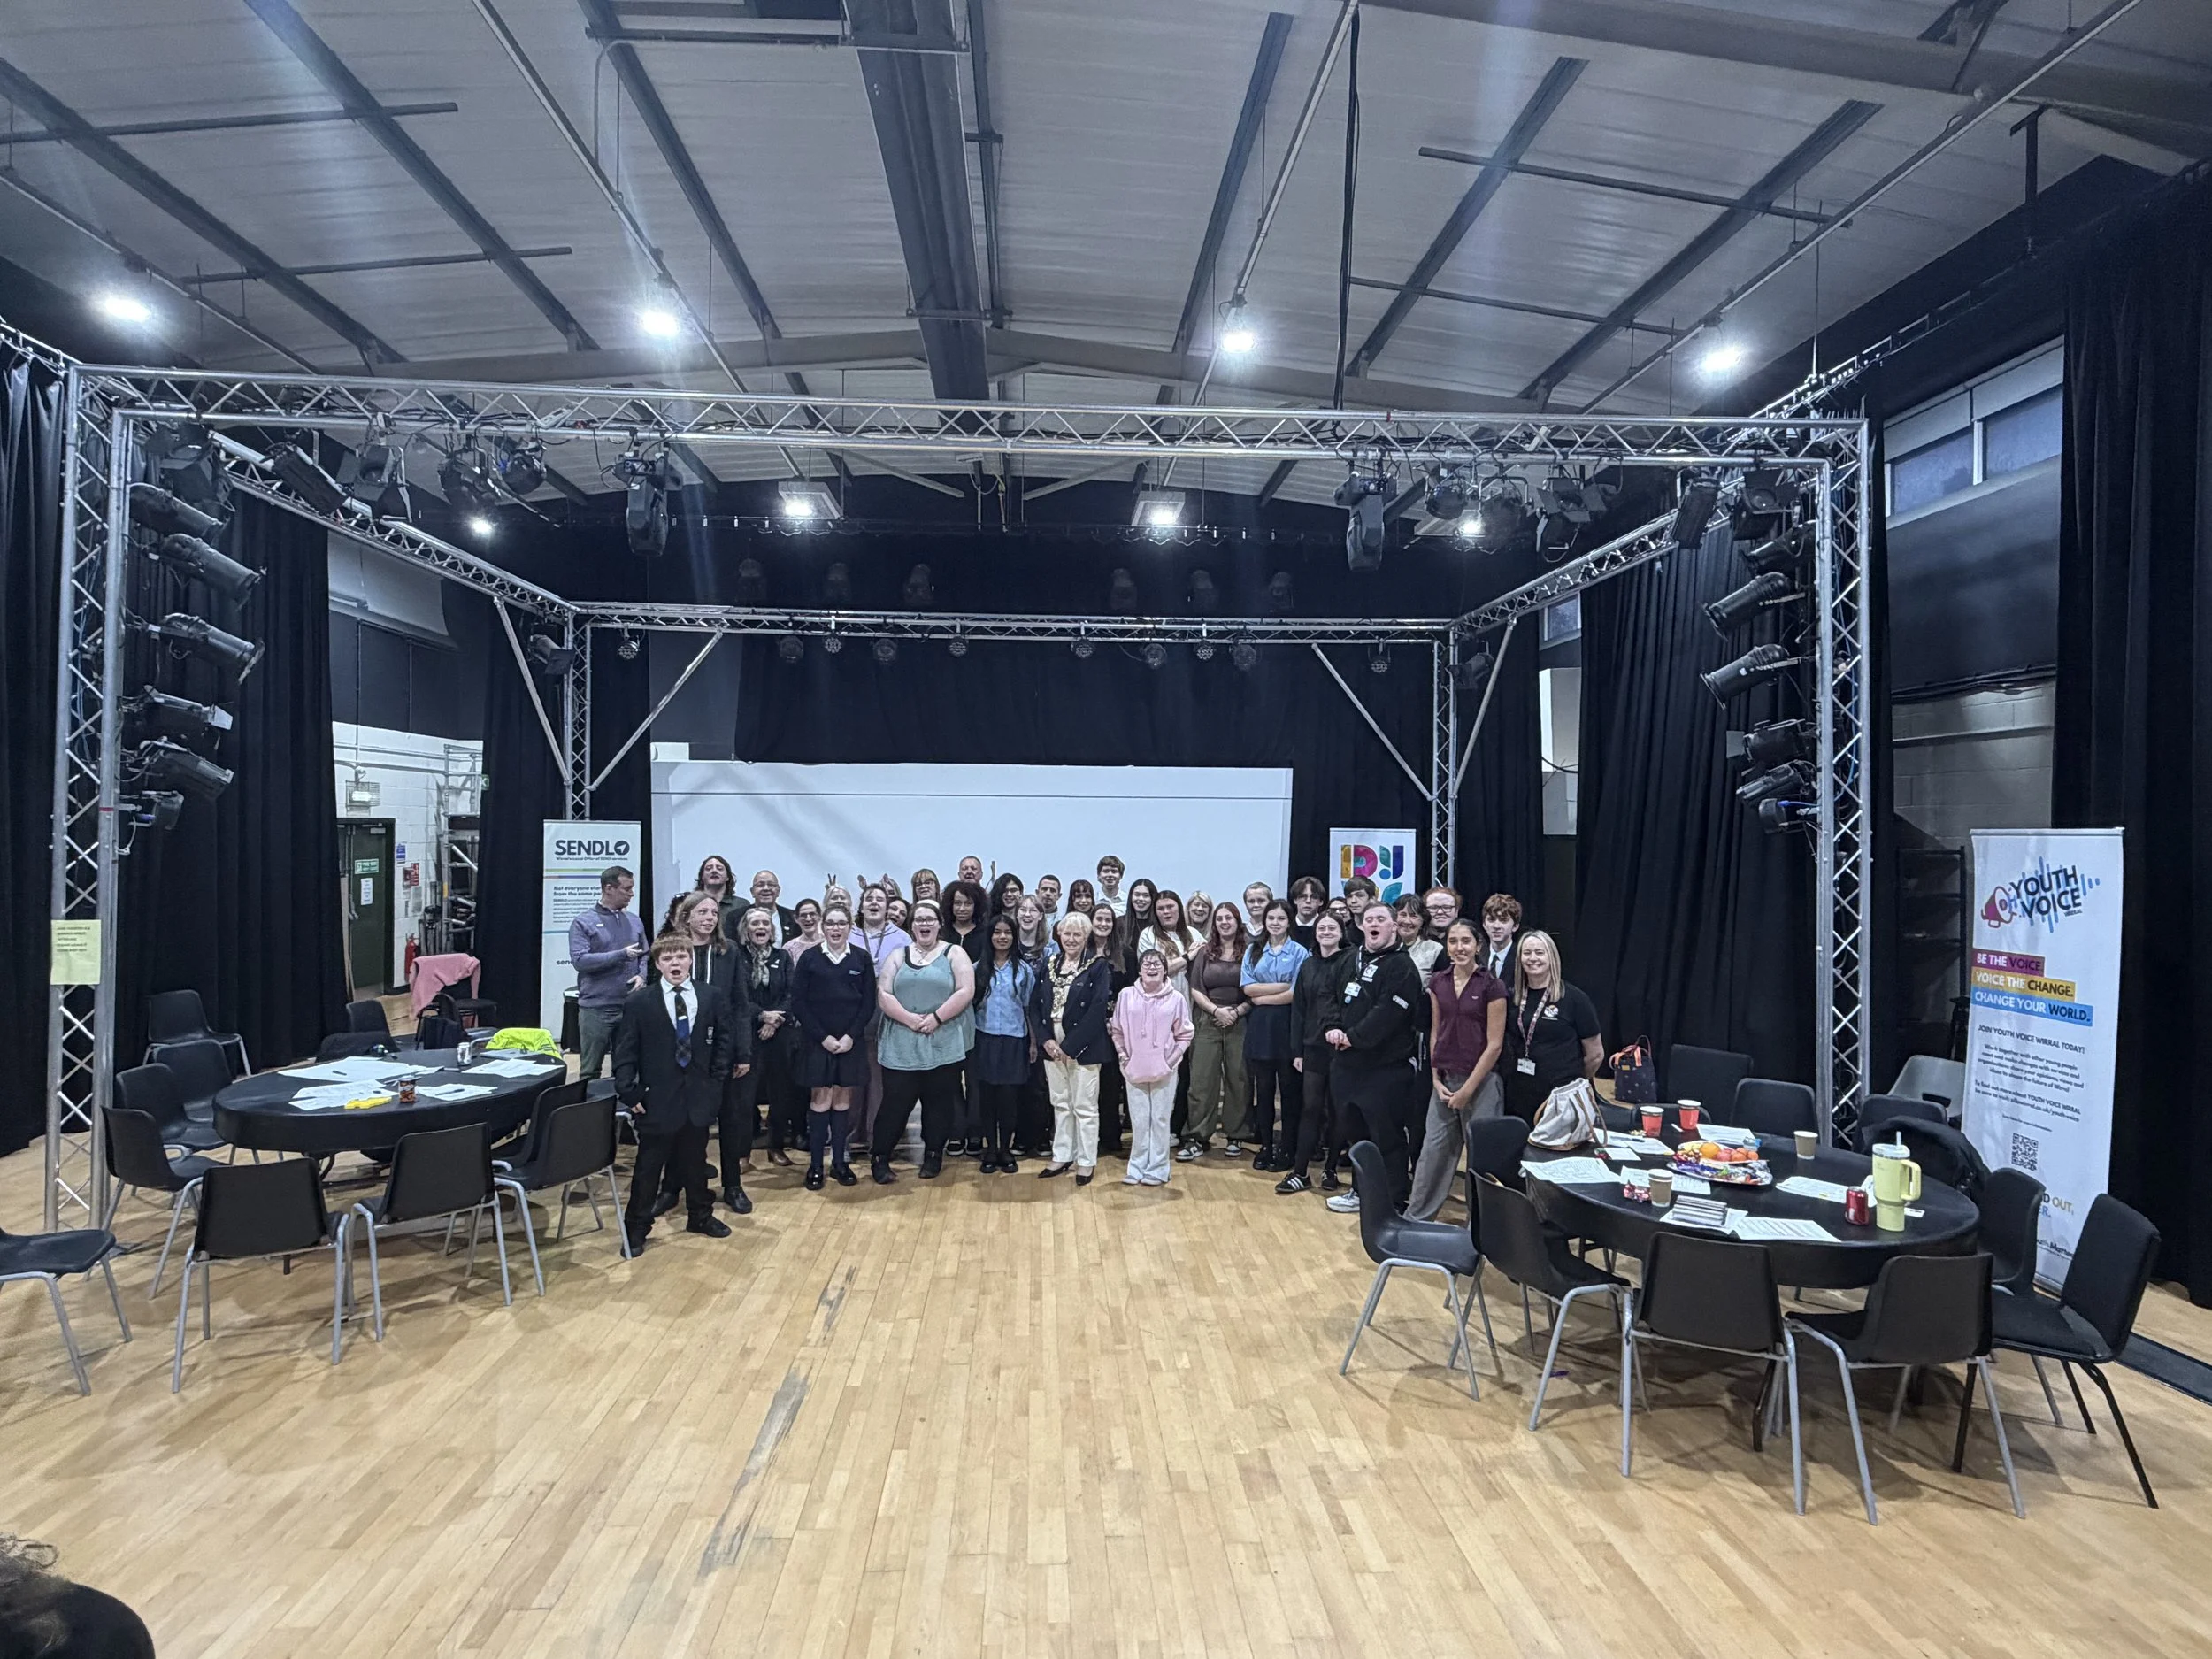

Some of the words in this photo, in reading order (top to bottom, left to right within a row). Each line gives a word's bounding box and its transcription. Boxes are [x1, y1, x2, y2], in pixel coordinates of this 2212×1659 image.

[555, 840, 630, 856] SENDLO
[2009, 865, 2078, 899] YOUTH
[2020, 887, 2082, 918] VOICE
[1977, 953, 1987, 964] BE
[1988, 955, 2008, 967] THE
[1977, 972, 2004, 986] VOICE
[2007, 976, 2025, 989] THE
[2028, 979, 2073, 997] CHANGE.
[1975, 991, 2015, 1007] CHANGE
[2017, 997, 2047, 1014] YOUR
[2048, 1003, 2091, 1022] WORLD.
[1993, 1028, 2015, 1038] YOUTH
[2016, 1032, 2035, 1042] VOICE
[2036, 1037, 2060, 1048] WIRRAL
[2062, 1041, 2085, 1054] TODAY!
